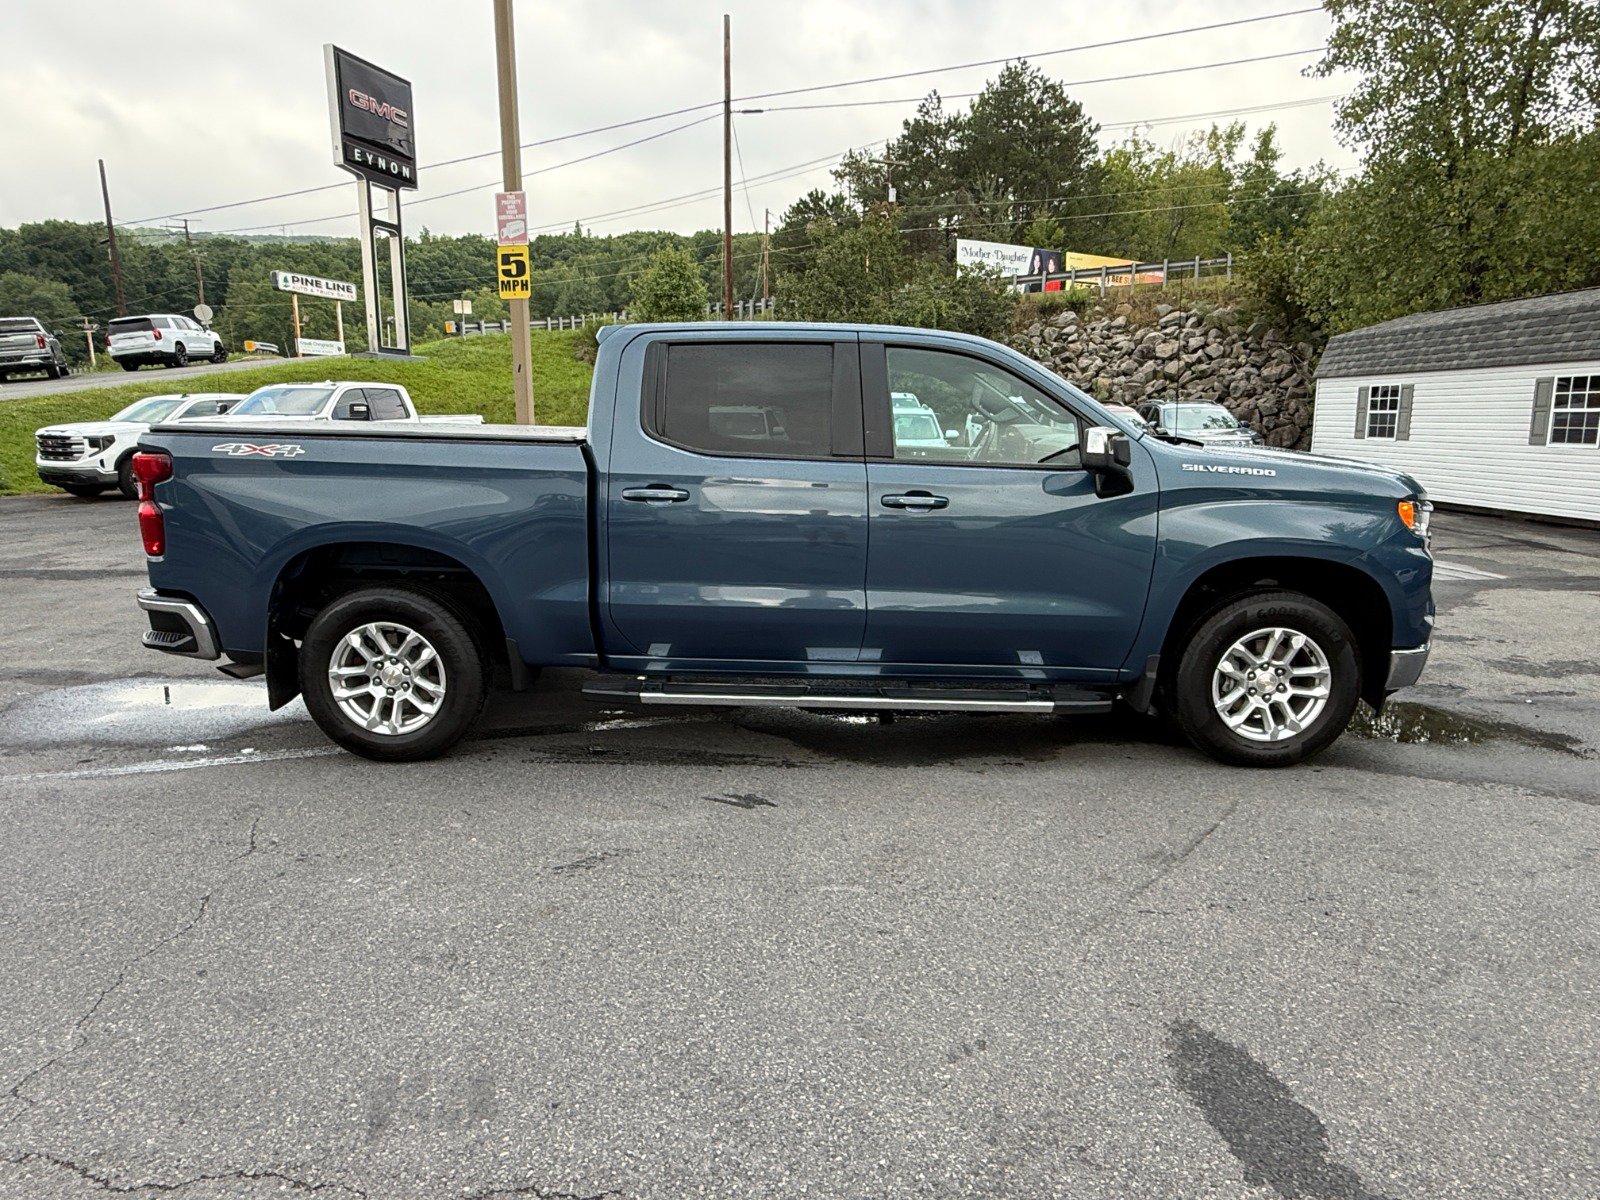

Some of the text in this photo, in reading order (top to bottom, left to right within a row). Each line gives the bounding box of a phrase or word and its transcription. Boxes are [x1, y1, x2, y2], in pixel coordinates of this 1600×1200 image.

[348, 88, 408, 128] GMC
[354, 148, 410, 179] EYNON
[961, 246, 991, 259] Mother
[501, 253, 526, 278] 5
[292, 276, 353, 293] PINE LINE
[500, 279, 529, 292] MPH
[1181, 463, 1277, 477] SILVERADO
